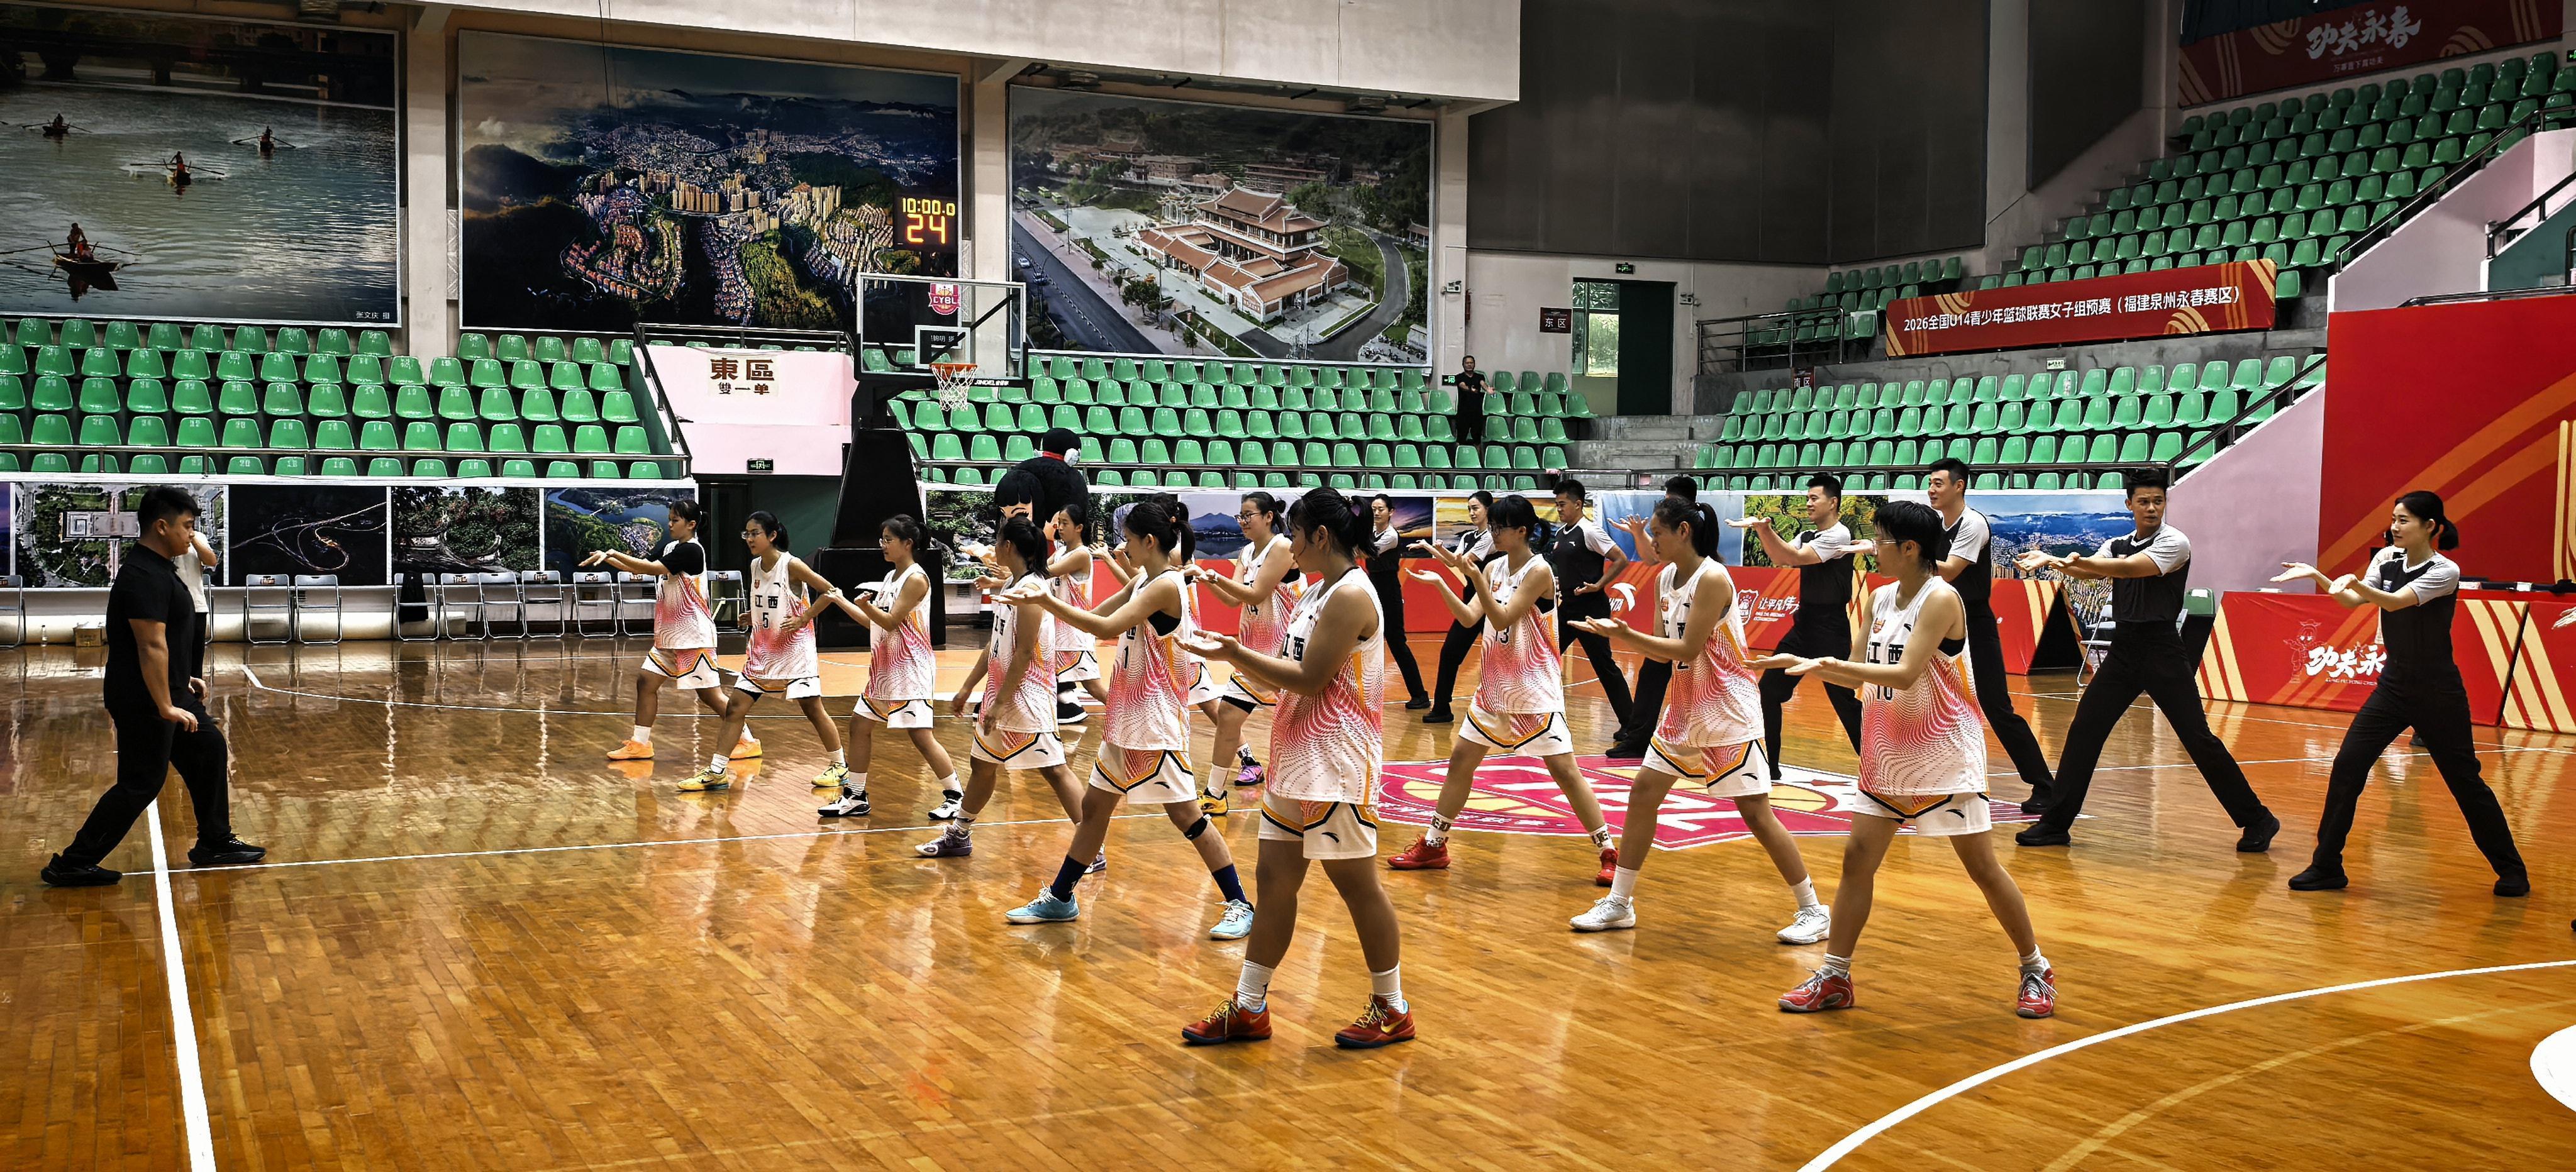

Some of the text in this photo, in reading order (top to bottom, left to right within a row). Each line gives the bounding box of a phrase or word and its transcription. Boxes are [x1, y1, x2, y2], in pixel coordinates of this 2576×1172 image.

[2306, 5, 2421, 60] 功夫永春
[902, 197, 955, 216] 10:00.0
[907, 213, 945, 243] 24
[933, 296, 957, 305] CYBL
[1545, 317, 1566, 328] 东区
[710, 357, 774, 381] 東區
[755, 594, 779, 609] 江西
[1608, 598, 1624, 611] NTA
[762, 612, 769, 628] 5
[1867, 642, 1904, 665] 江西
